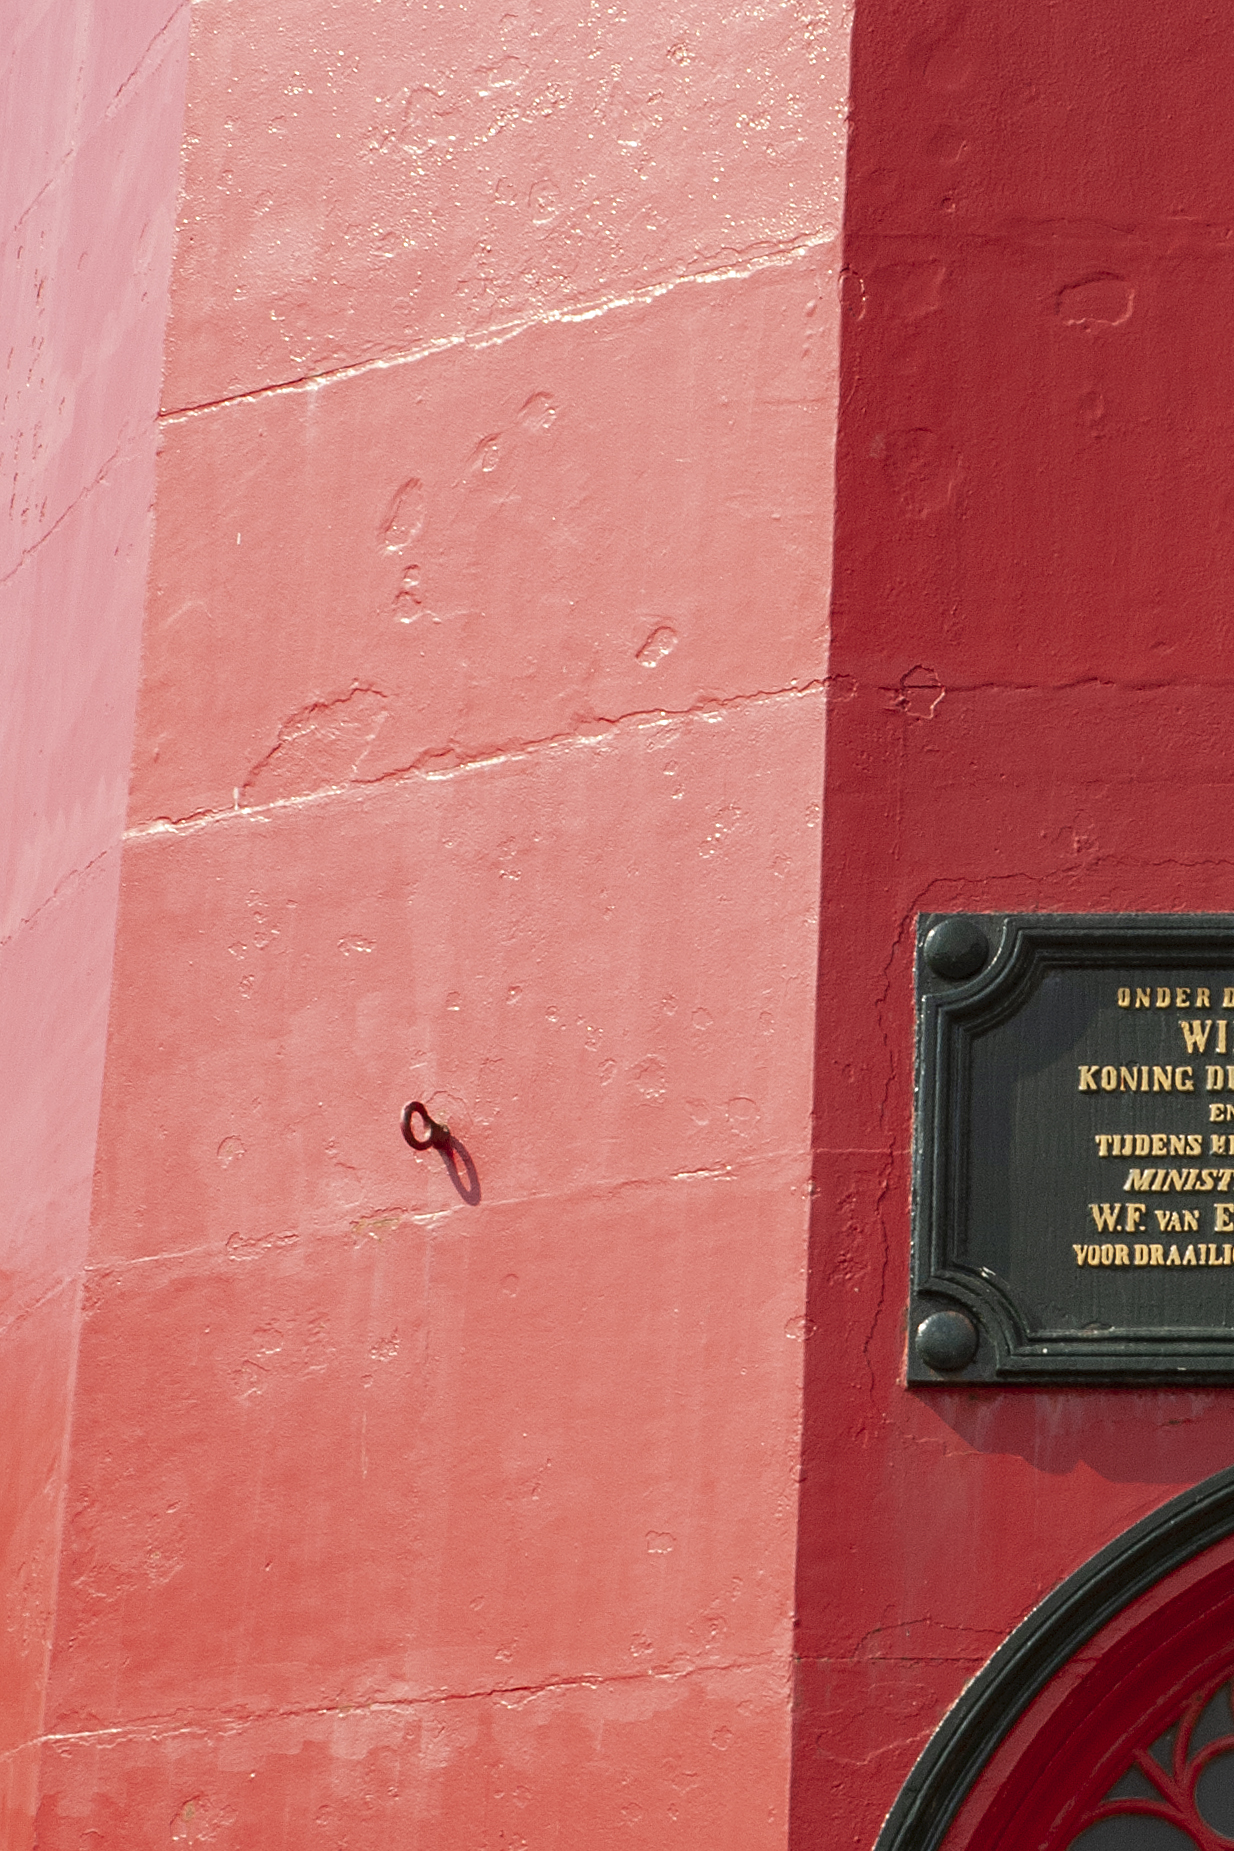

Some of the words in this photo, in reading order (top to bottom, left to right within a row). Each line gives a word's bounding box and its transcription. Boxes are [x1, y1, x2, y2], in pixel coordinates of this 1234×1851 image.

[1117, 987, 1210, 1008] ONDER
[1078, 1065, 1195, 1091] KONING
[1094, 1134, 1203, 1156] TIJDENS
[1089, 1202, 1147, 1232] W.F.
[1154, 1210, 1200, 1232] VAN
[1072, 1244, 1131, 1266] VOOR
